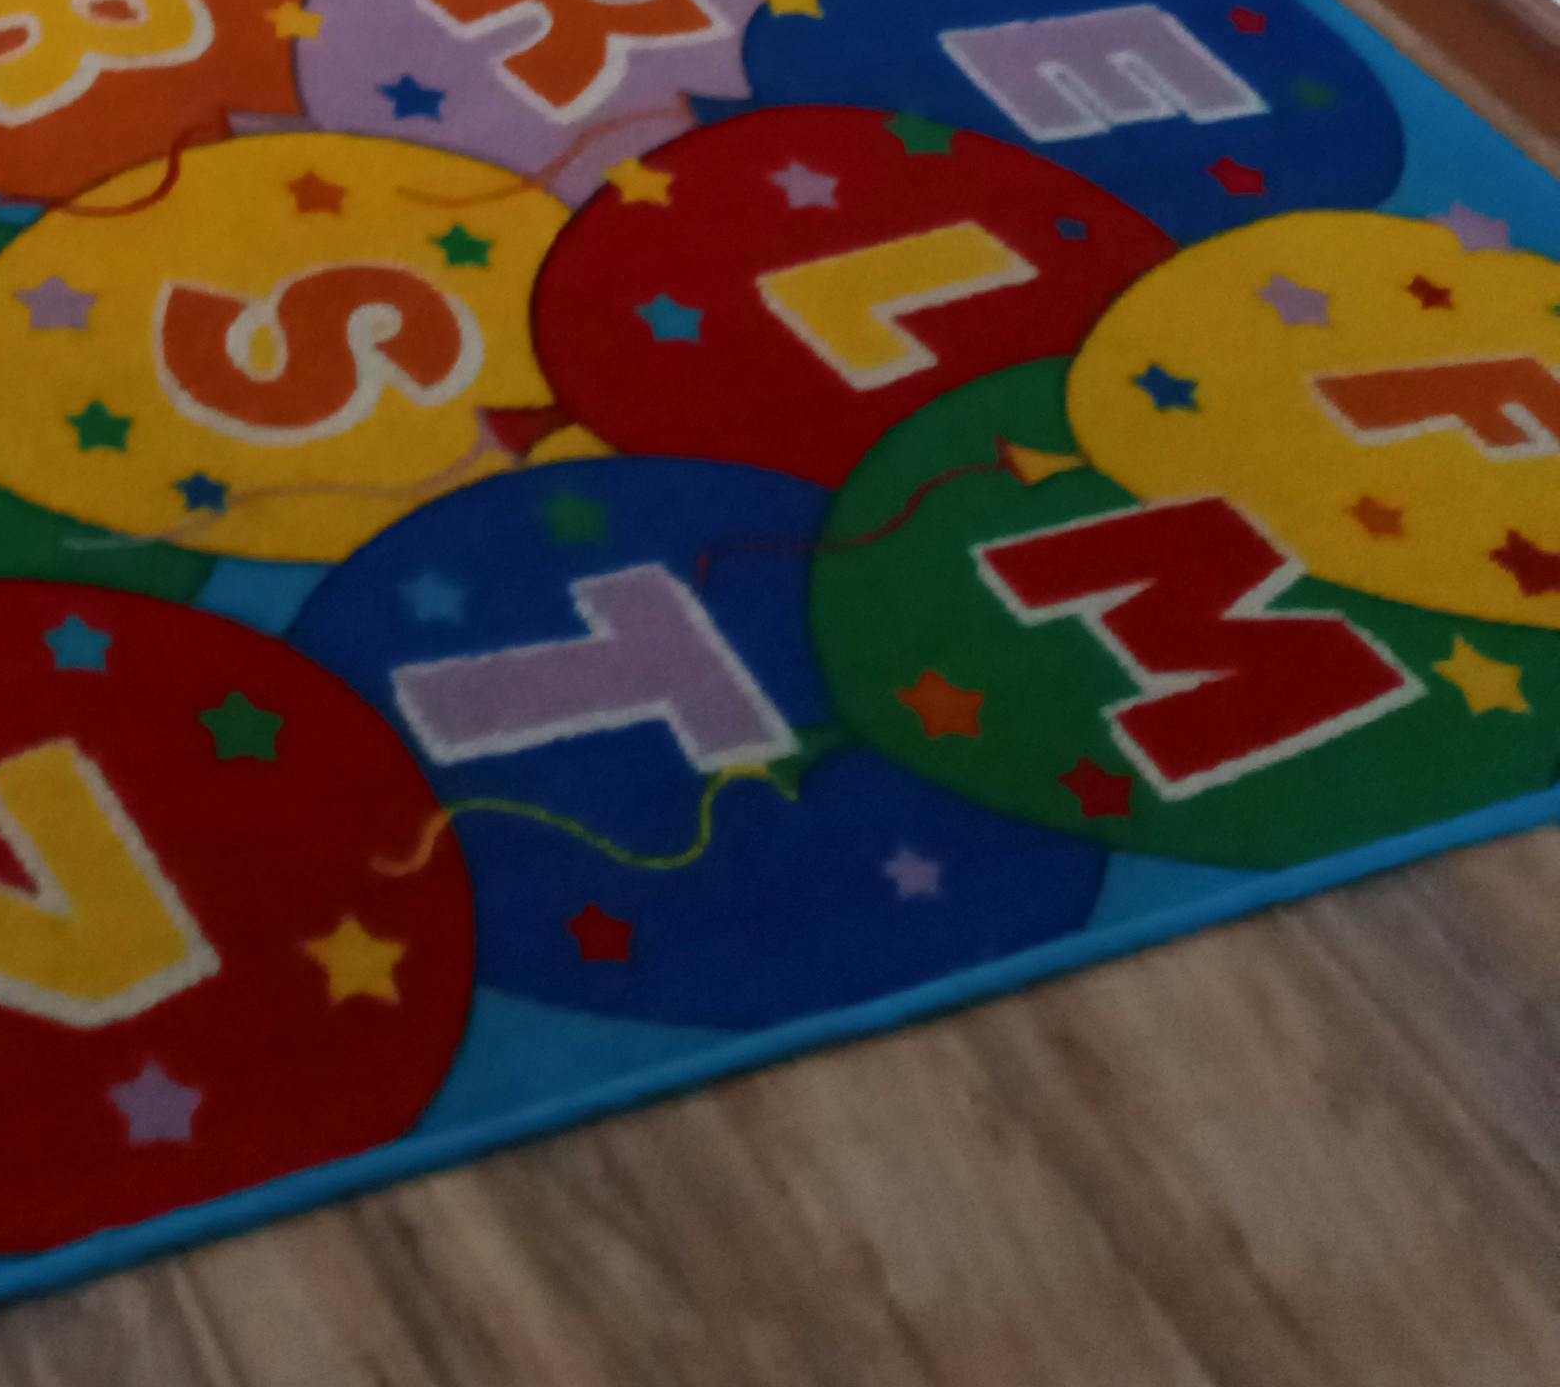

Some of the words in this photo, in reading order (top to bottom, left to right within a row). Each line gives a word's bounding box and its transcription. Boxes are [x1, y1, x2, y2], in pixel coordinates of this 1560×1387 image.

[937, 4, 1271, 143] E
[153, 263, 483, 447] S
[755, 222, 1040, 391] L
[1311, 355, 1560, 462] F
[390, 562, 802, 772] T
[971, 494, 1427, 804] M
